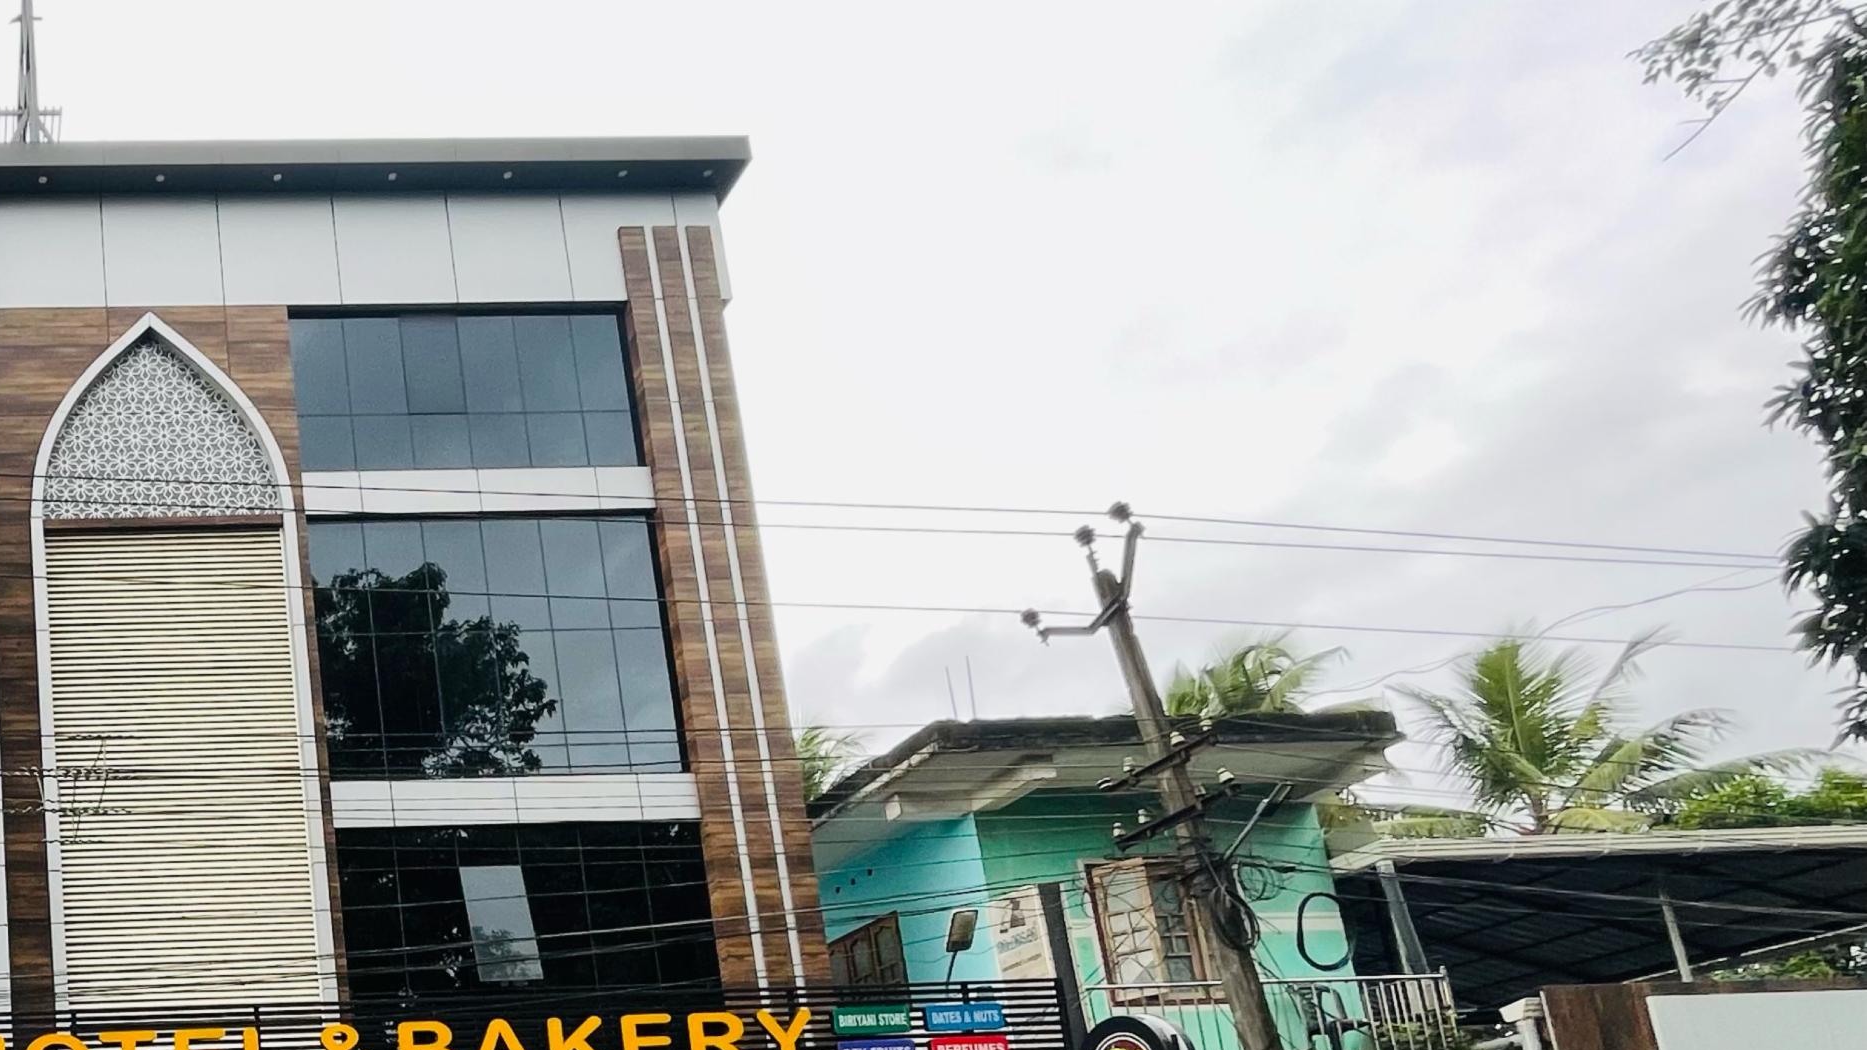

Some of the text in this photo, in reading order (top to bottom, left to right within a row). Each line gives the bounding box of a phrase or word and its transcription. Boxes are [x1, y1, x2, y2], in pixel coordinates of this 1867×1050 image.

[838, 1011, 909, 1027] BIRIYANI STORE
[931, 1009, 1000, 1025] DATES & NUTS
